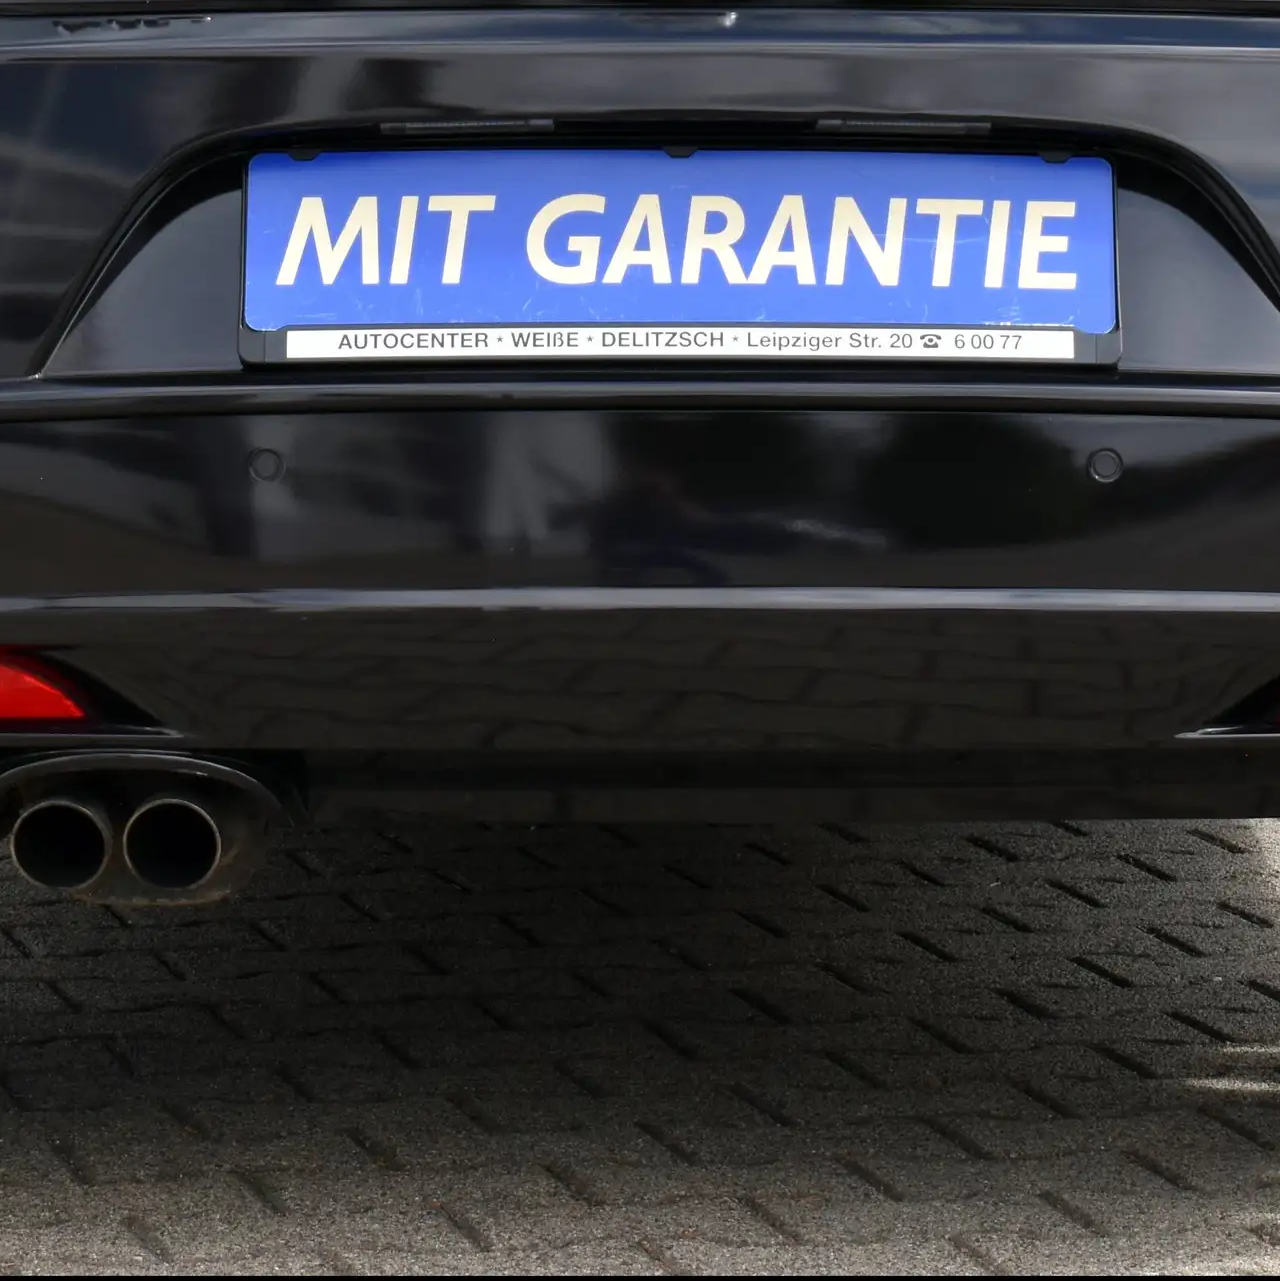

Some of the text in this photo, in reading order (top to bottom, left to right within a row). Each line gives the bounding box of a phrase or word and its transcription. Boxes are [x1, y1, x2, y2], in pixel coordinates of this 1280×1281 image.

[275, 193, 1078, 290] MIT GARANTIE
[338, 332, 489, 350] AUTOCENTER
[511, 331, 579, 348] WEIßE
[601, 331, 724, 348] DELITZSCH
[747, 331, 843, 352] Leipziger
[849, 332, 882, 350] Str.
[889, 332, 914, 350] 20
